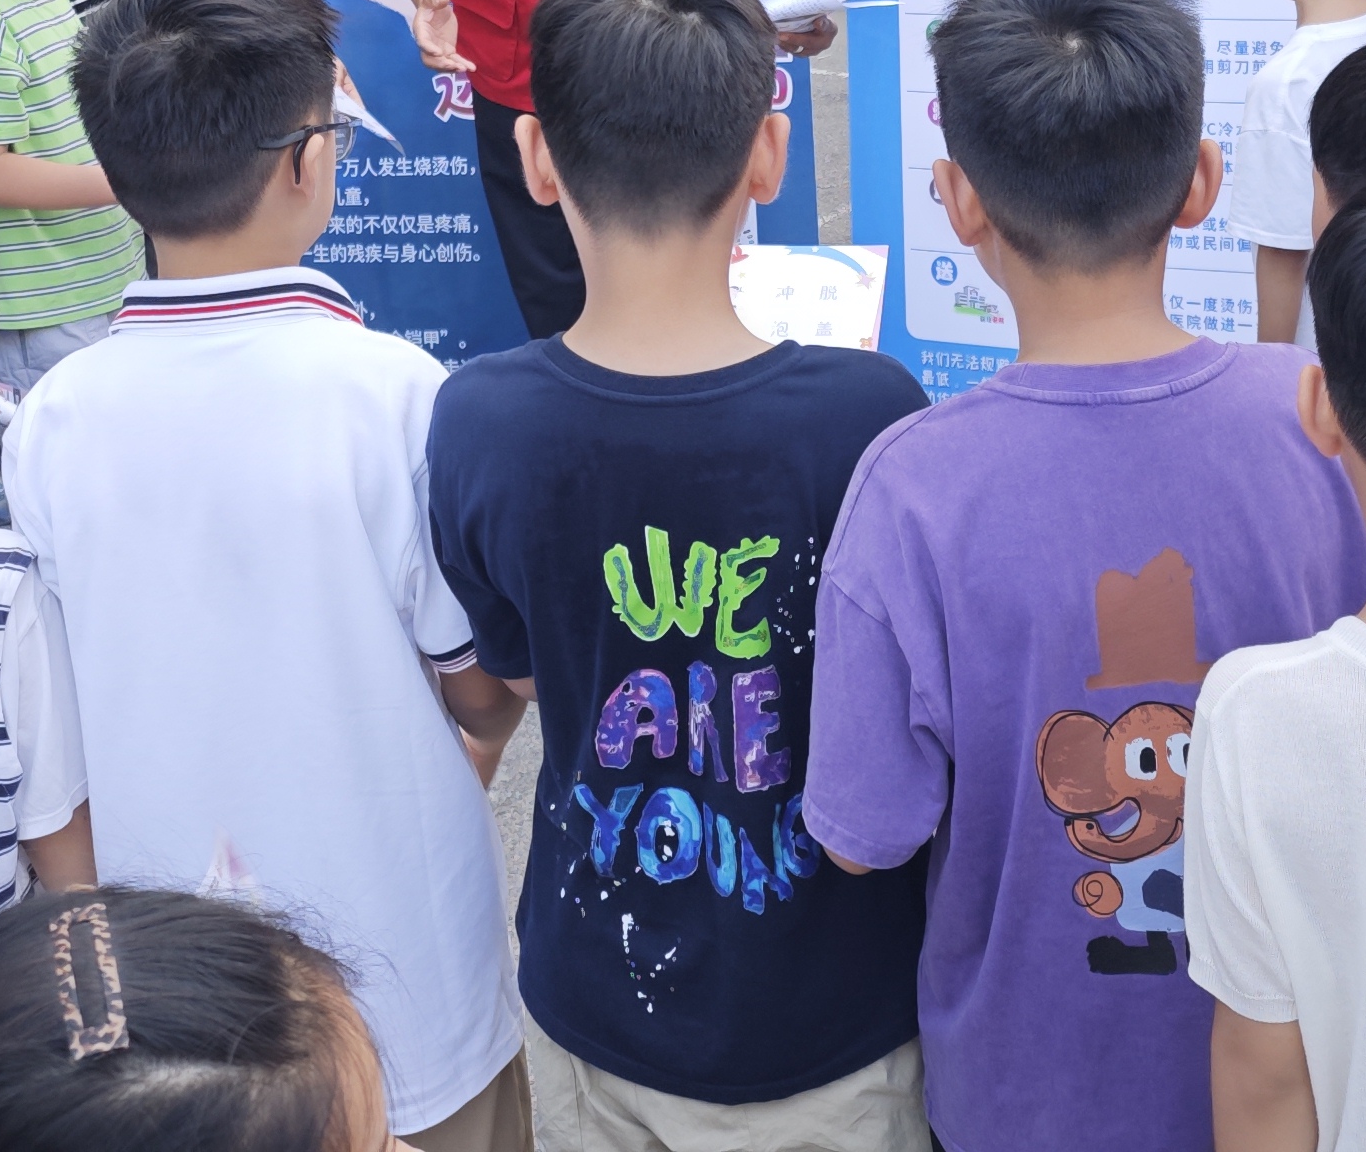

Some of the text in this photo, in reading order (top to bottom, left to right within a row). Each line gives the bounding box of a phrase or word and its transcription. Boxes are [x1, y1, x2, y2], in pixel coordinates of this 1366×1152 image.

[323, 214, 479, 235] 来的不仅仅是疼痛，
[603, 525, 780, 659] WE
[595, 660, 791, 793] ARE
[573, 783, 822, 916] YOUNG
